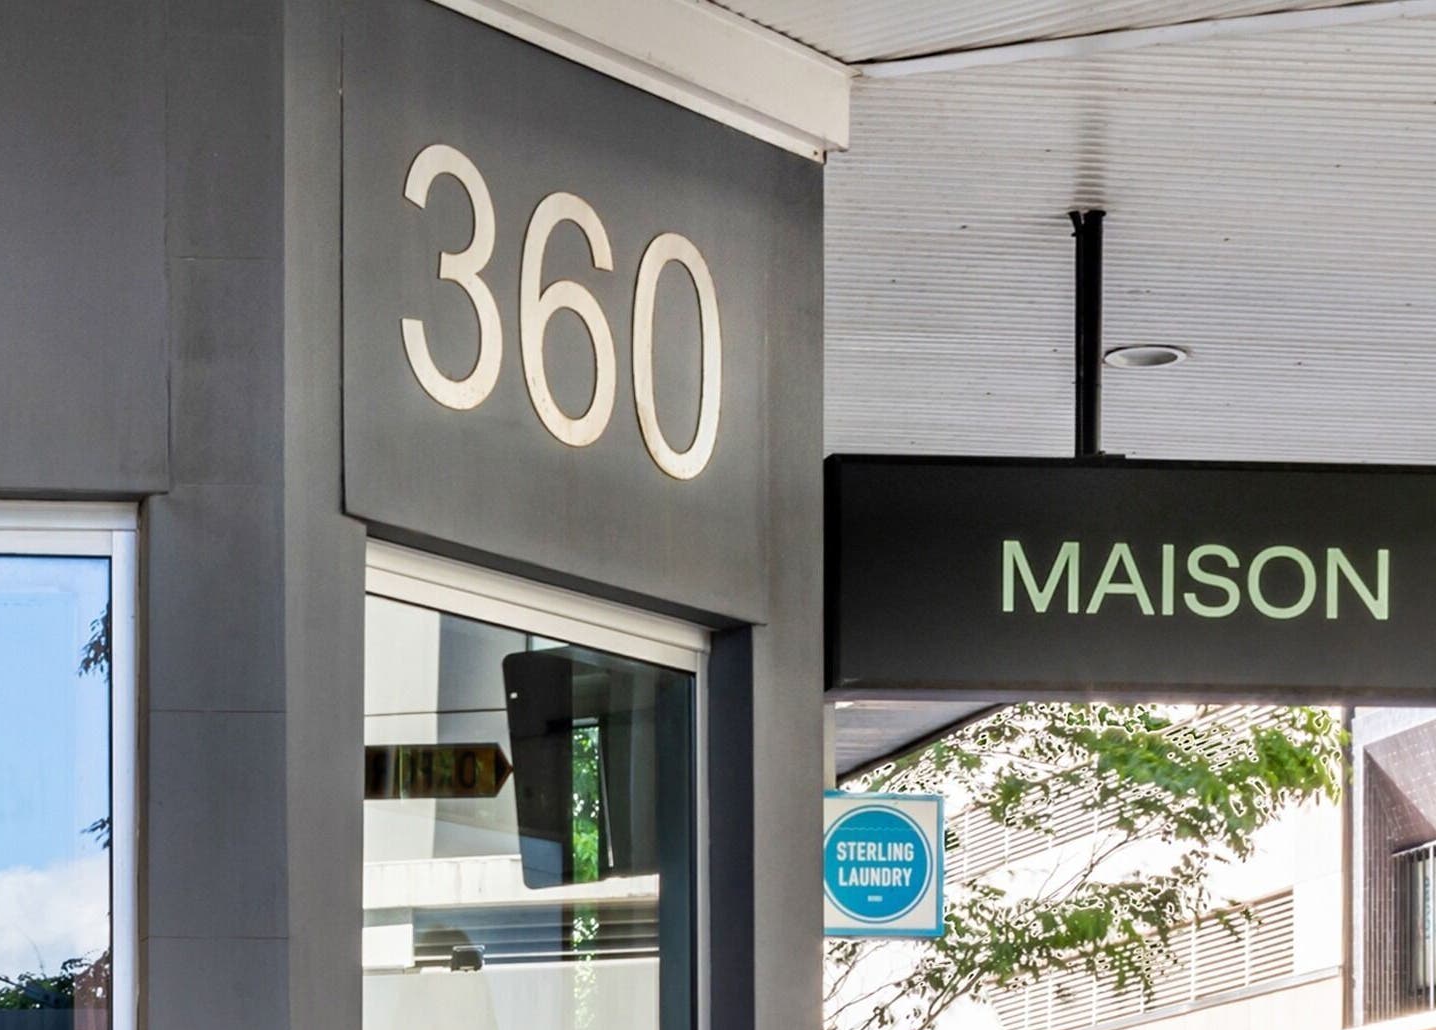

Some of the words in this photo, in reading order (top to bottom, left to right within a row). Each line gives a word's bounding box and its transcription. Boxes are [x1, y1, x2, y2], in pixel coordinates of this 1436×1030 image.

[401, 144, 722, 480] 360
[1002, 539, 1390, 620] MAISON
[836, 841, 915, 862] STERLING
[838, 866, 913, 887] LAUNDRY
